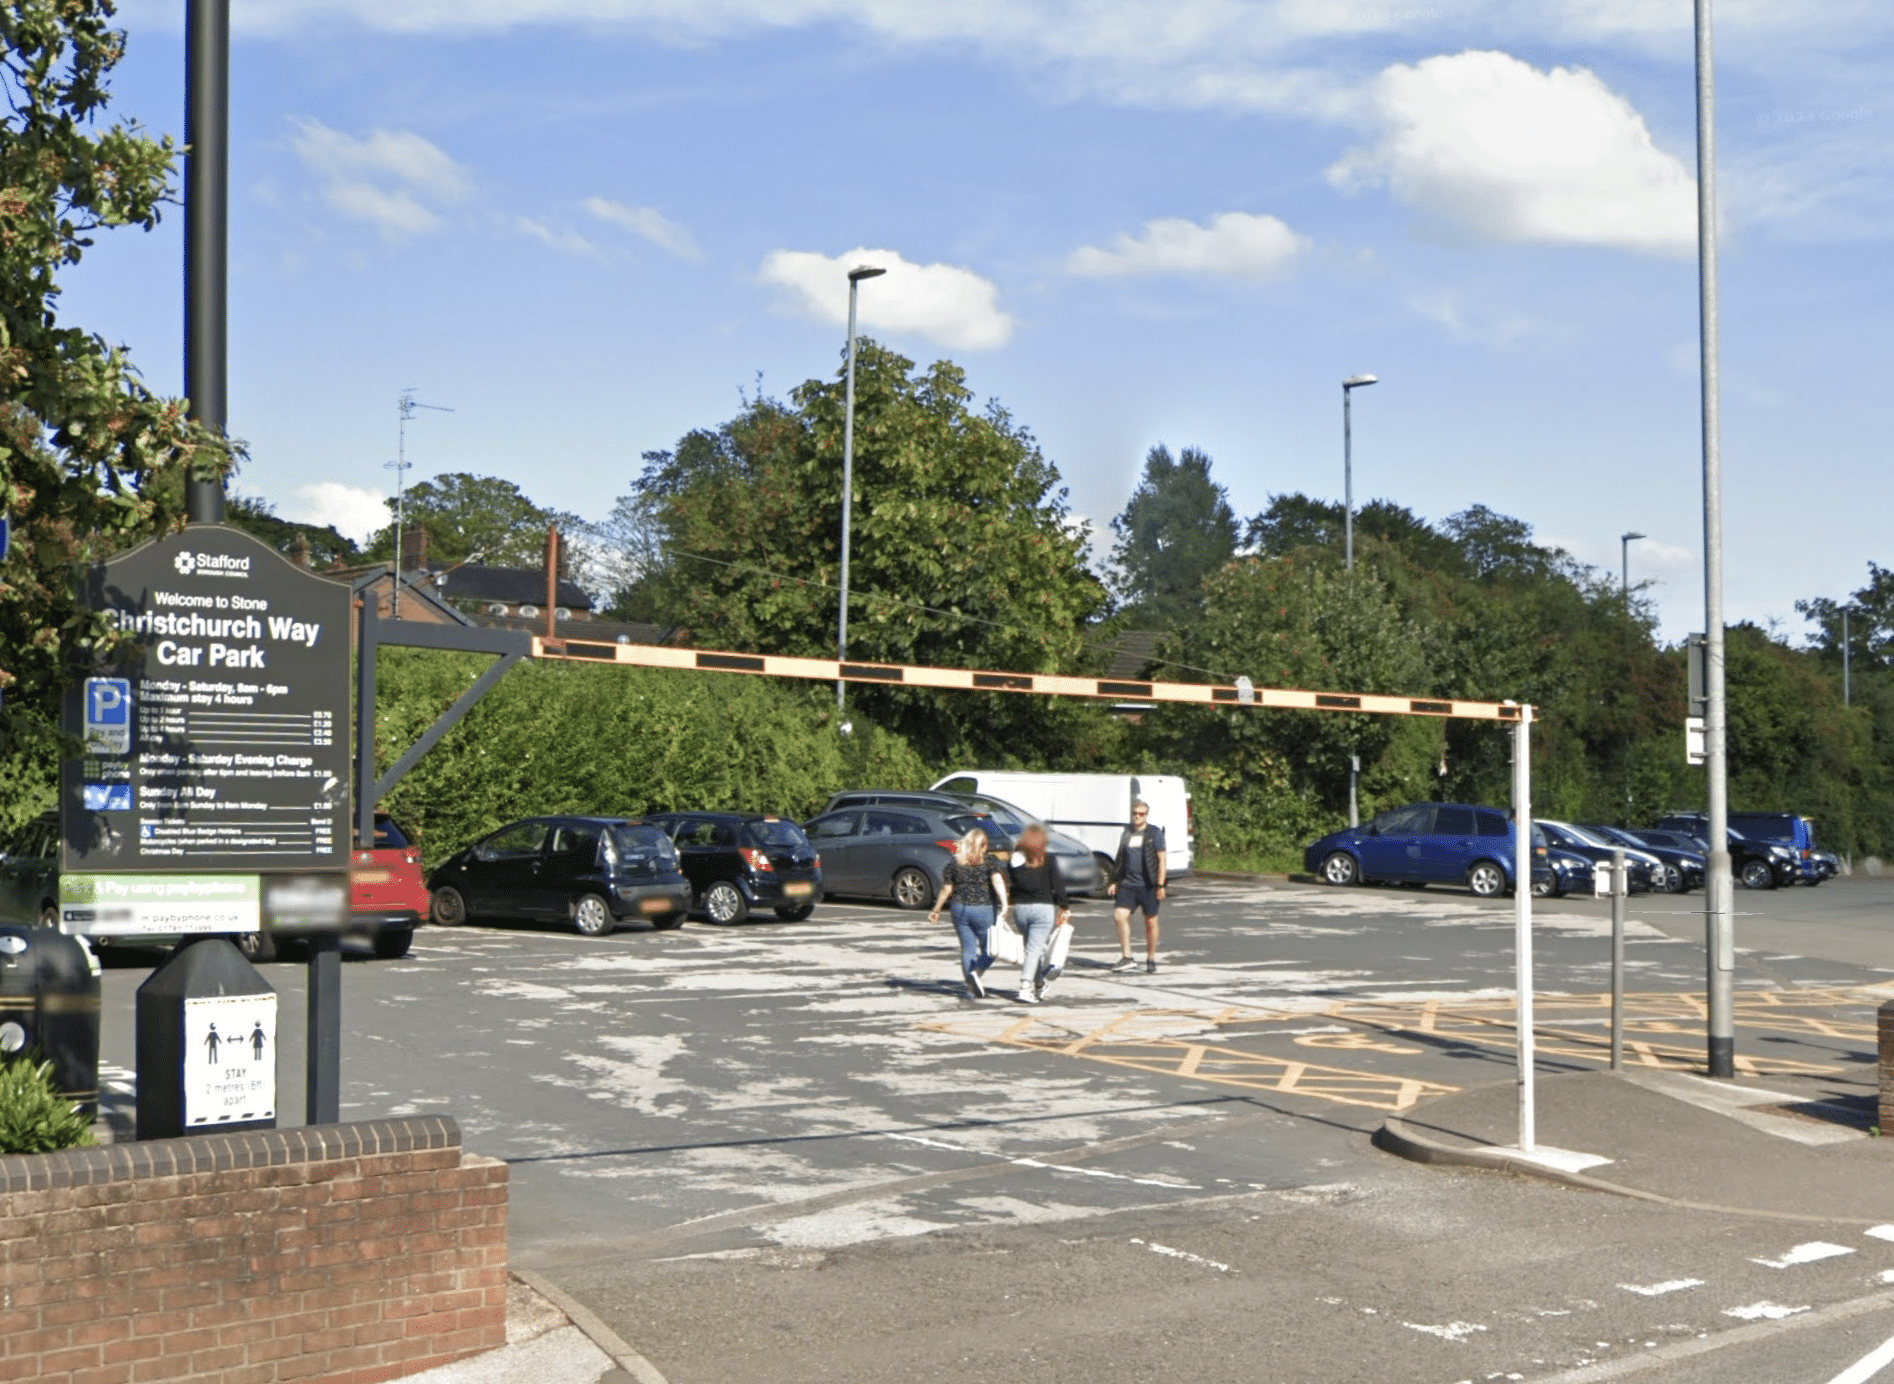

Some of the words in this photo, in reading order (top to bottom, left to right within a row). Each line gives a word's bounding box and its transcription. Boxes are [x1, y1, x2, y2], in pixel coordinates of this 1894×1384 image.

[196, 553, 250, 570] Stafford
[154, 591, 213, 608] Welcome
[216, 596, 228, 608] to
[231, 595, 268, 611] Stone
[268, 616, 320, 647] Way
[157, 640, 203, 666] Car
[209, 643, 265, 668] Park
[140, 679, 181, 693] Monday
[189, 680, 235, 695] Saturday,
[266, 683, 289, 696] 6pm
[95, 685, 121, 721] P
[140, 690, 189, 703] Maximum
[191, 693, 213, 706] stay
[214, 694, 222, 704] 4
[223, 694, 254, 705] hours
[140, 753, 180, 766] Monday
[188, 753, 233, 767] Saturday
[235, 754, 275, 768] Evening
[276, 754, 313, 768] Charge
[140, 767, 156, 777] Only
[140, 785, 178, 800] Sunday
[180, 786, 194, 797] All
[195, 786, 217, 800] Day
[140, 801, 156, 811] Only
[190, 801, 216, 811] Sunday
[240, 802, 268, 811] Monday
[315, 827, 332, 835] FREE
[315, 846, 332, 854] FREE
[105, 880, 129, 896] Pay
[130, 882, 165, 896] using
[225, 1068, 247, 1079] STAY
[206, 1084, 212, 1094] 2
[214, 1083, 244, 1094] metres
[223, 1094, 246, 1106] apart
